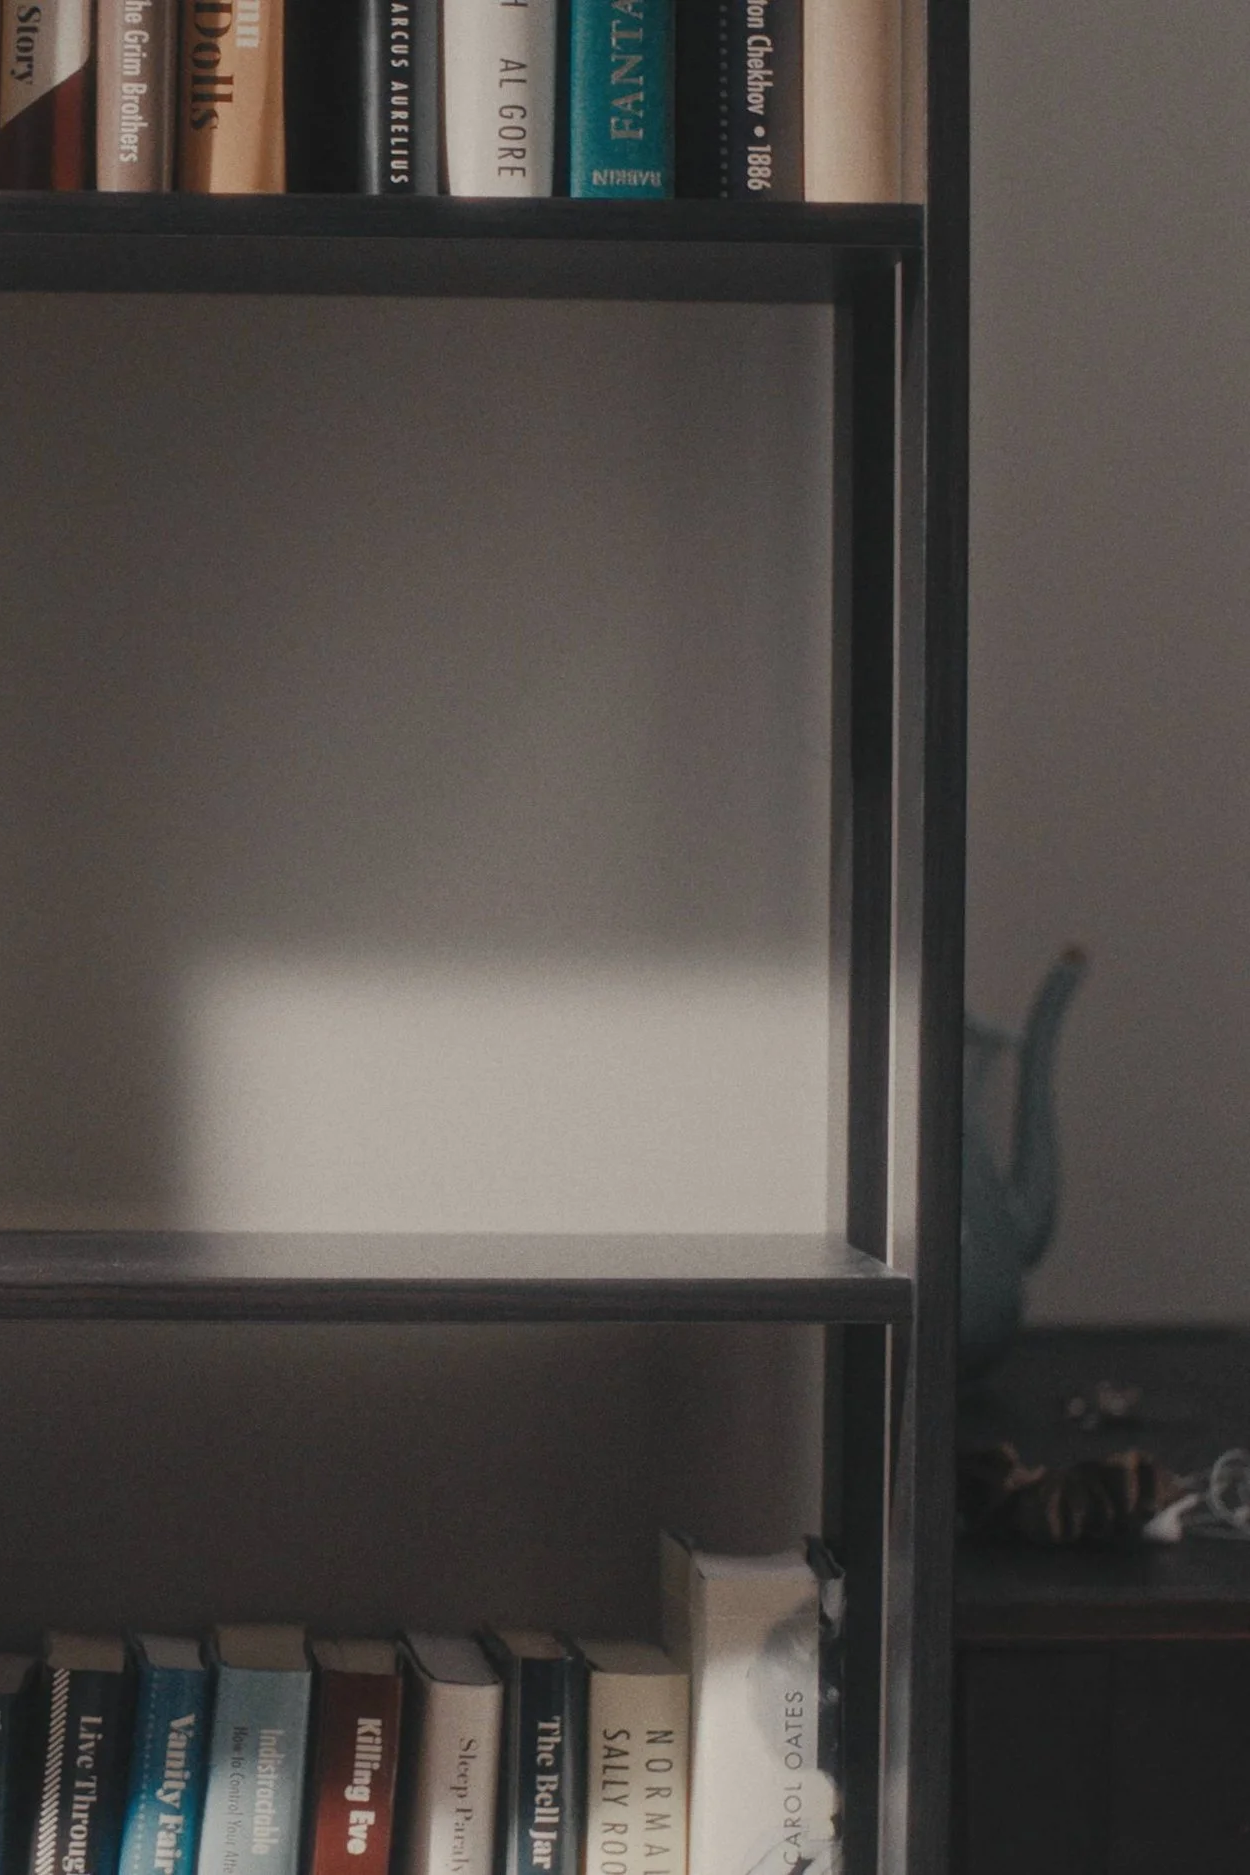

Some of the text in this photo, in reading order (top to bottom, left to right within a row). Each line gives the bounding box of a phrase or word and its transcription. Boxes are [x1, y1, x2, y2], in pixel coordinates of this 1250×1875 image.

[10, 4, 42, 84] Story
[122, 29, 150, 76] Grim
[191, 1, 234, 130] Dolls
[389, 2, 409, 185] ARCUS AURELIUS
[608, 0, 645, 141] FANTA
[745, 35, 774, 115] Chekhov
[118, 83, 149, 163] Brothers
[496, 58, 527, 178] AL GORE
[591, 168, 663, 188] RABKIN
[746, 145, 773, 191] 1886
[60, 1714, 103, 1875] Live Throug
[152, 1712, 197, 1875] Vanity Fair
[227, 1773, 245, 1818] Control
[231, 1726, 249, 1752] How
[250, 1727, 285, 1856] Indistractable
[344, 1716, 384, 1855] Killing Eve
[448, 1737, 480, 1797] Sleep
[531, 1714, 561, 1871] The Bell Jar
[783, 1691, 804, 1866] CAROL OATES
[225, 1819, 243, 1846] Your
[599, 1728, 630, 1875] SALLY ROO
